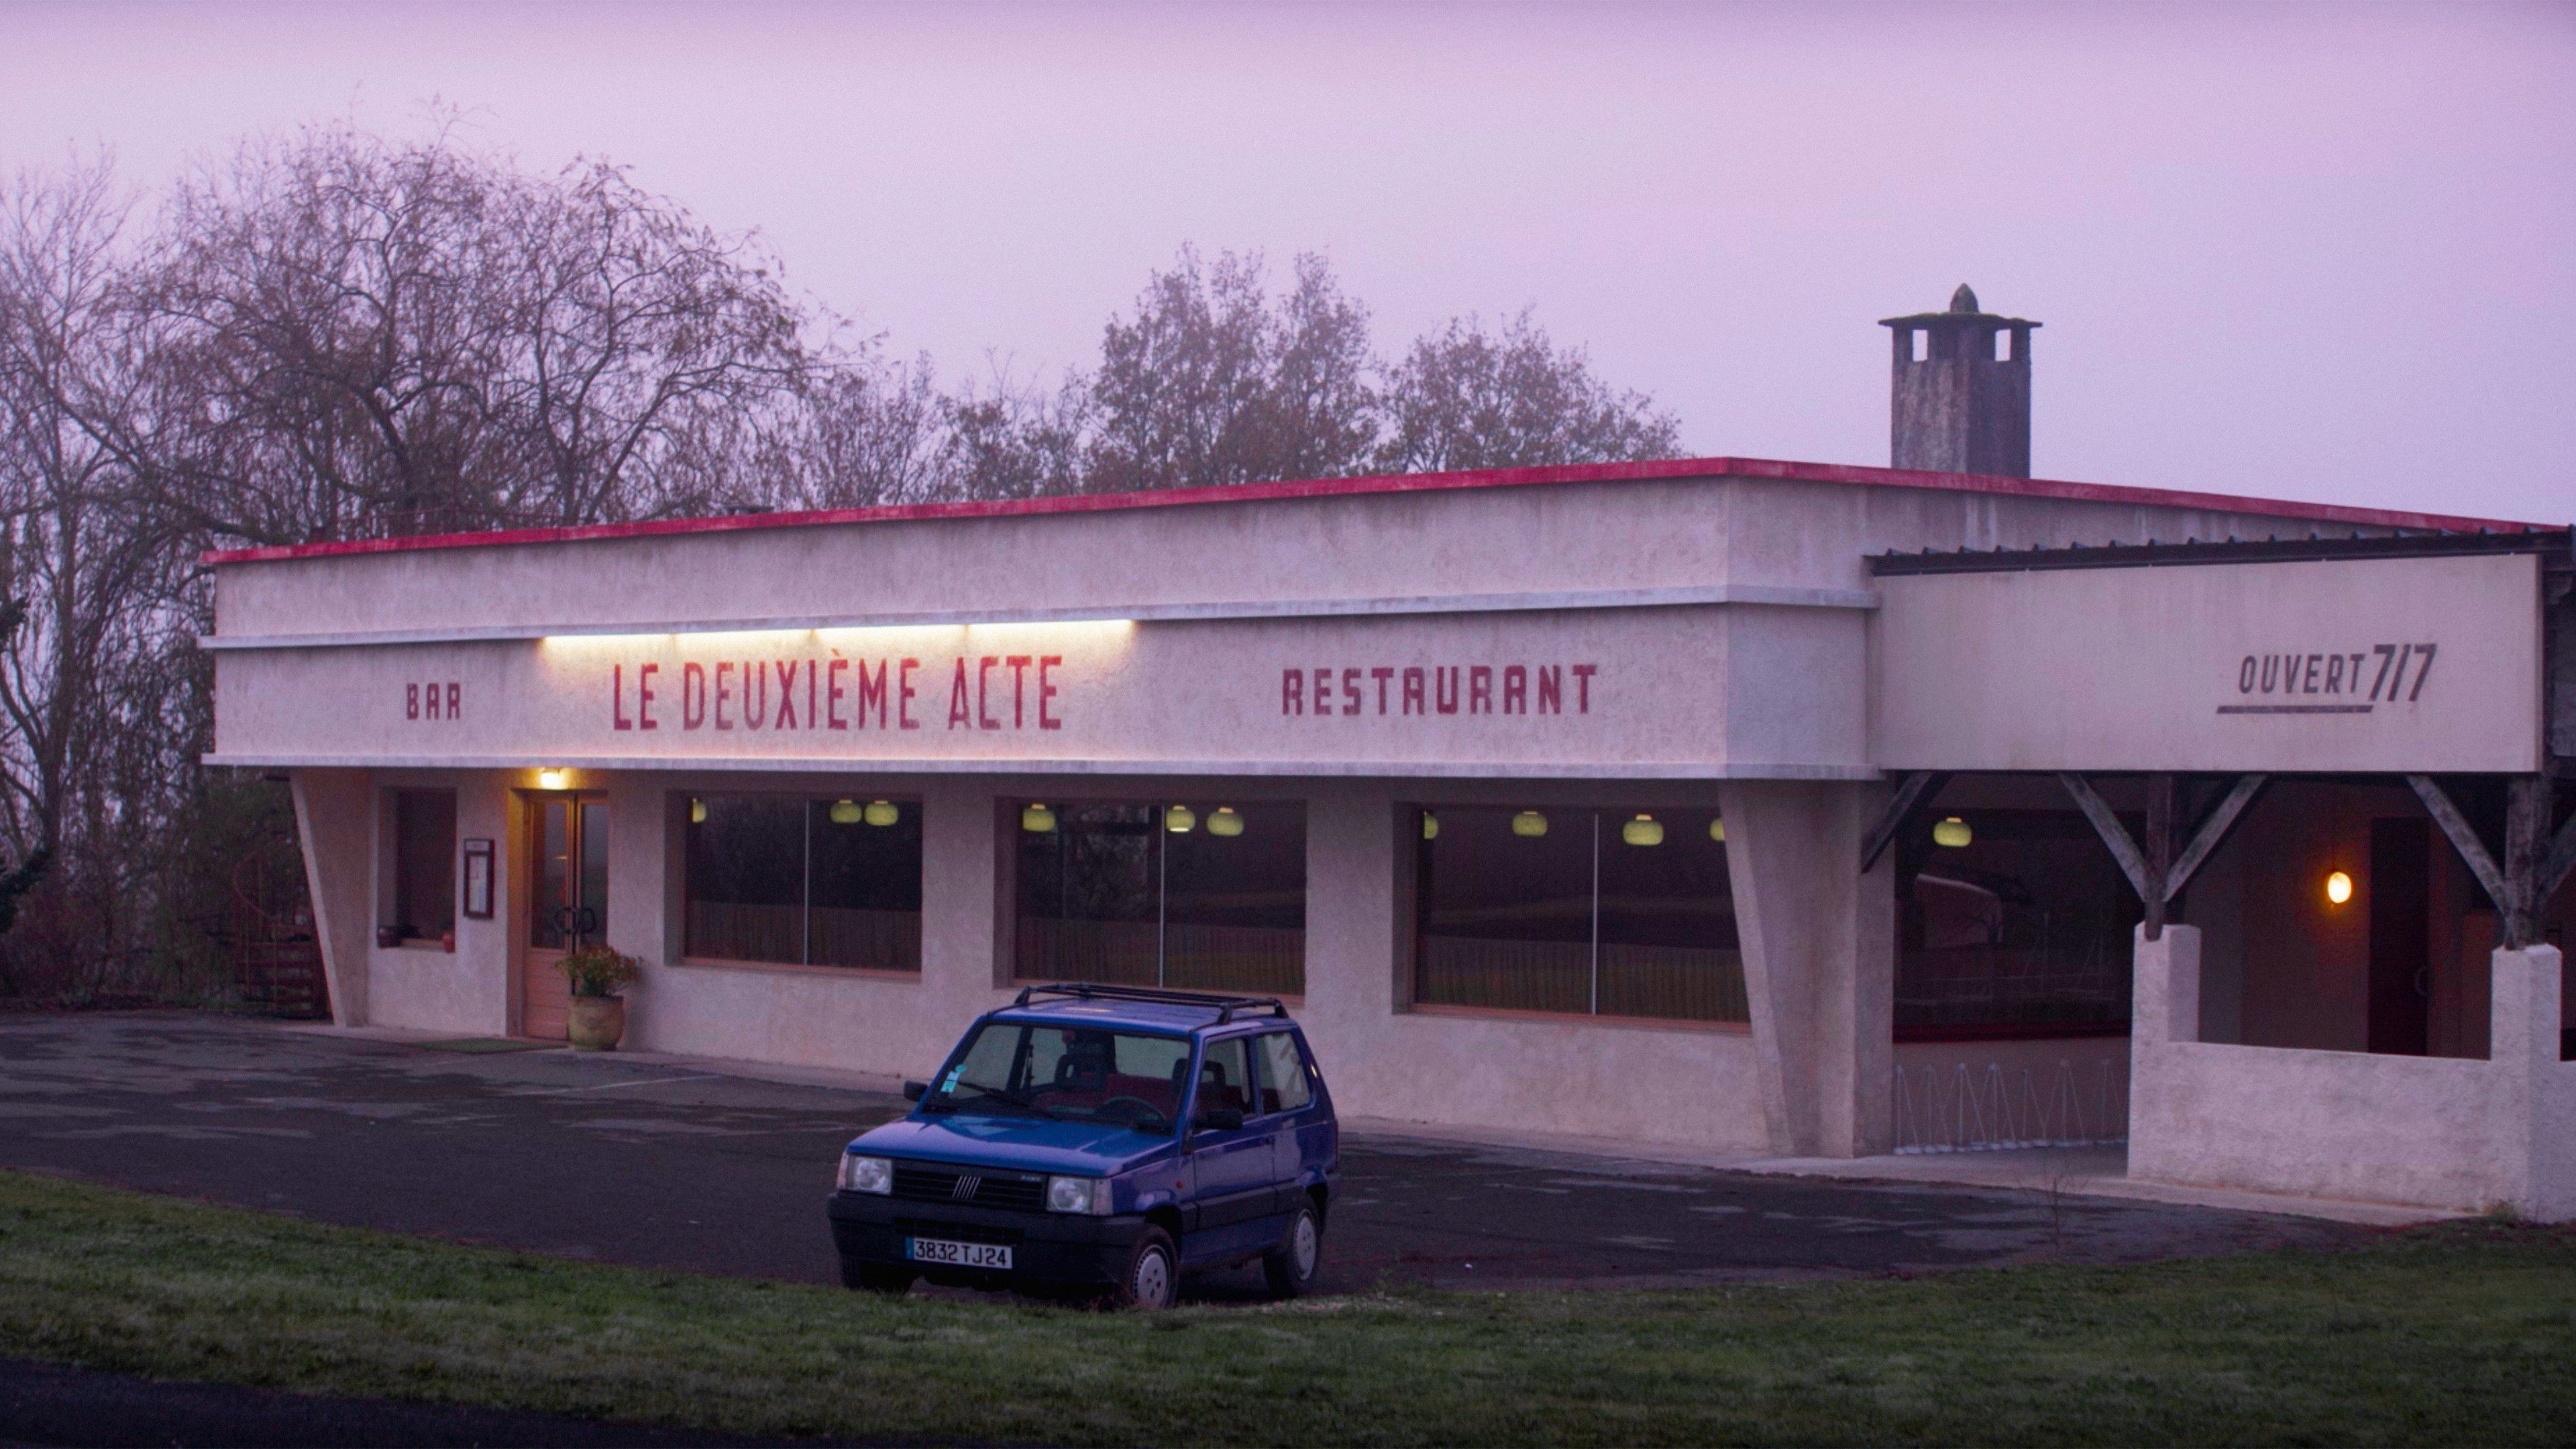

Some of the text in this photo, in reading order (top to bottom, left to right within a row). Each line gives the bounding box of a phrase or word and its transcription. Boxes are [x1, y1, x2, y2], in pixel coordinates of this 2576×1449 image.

[614, 649, 1063, 731] LE DEUXIÈME ACTE
[1282, 664, 1597, 716] RESTAURANT
[2239, 643, 2437, 702] OUVERT 7/7
[406, 682, 462, 720] BAR
